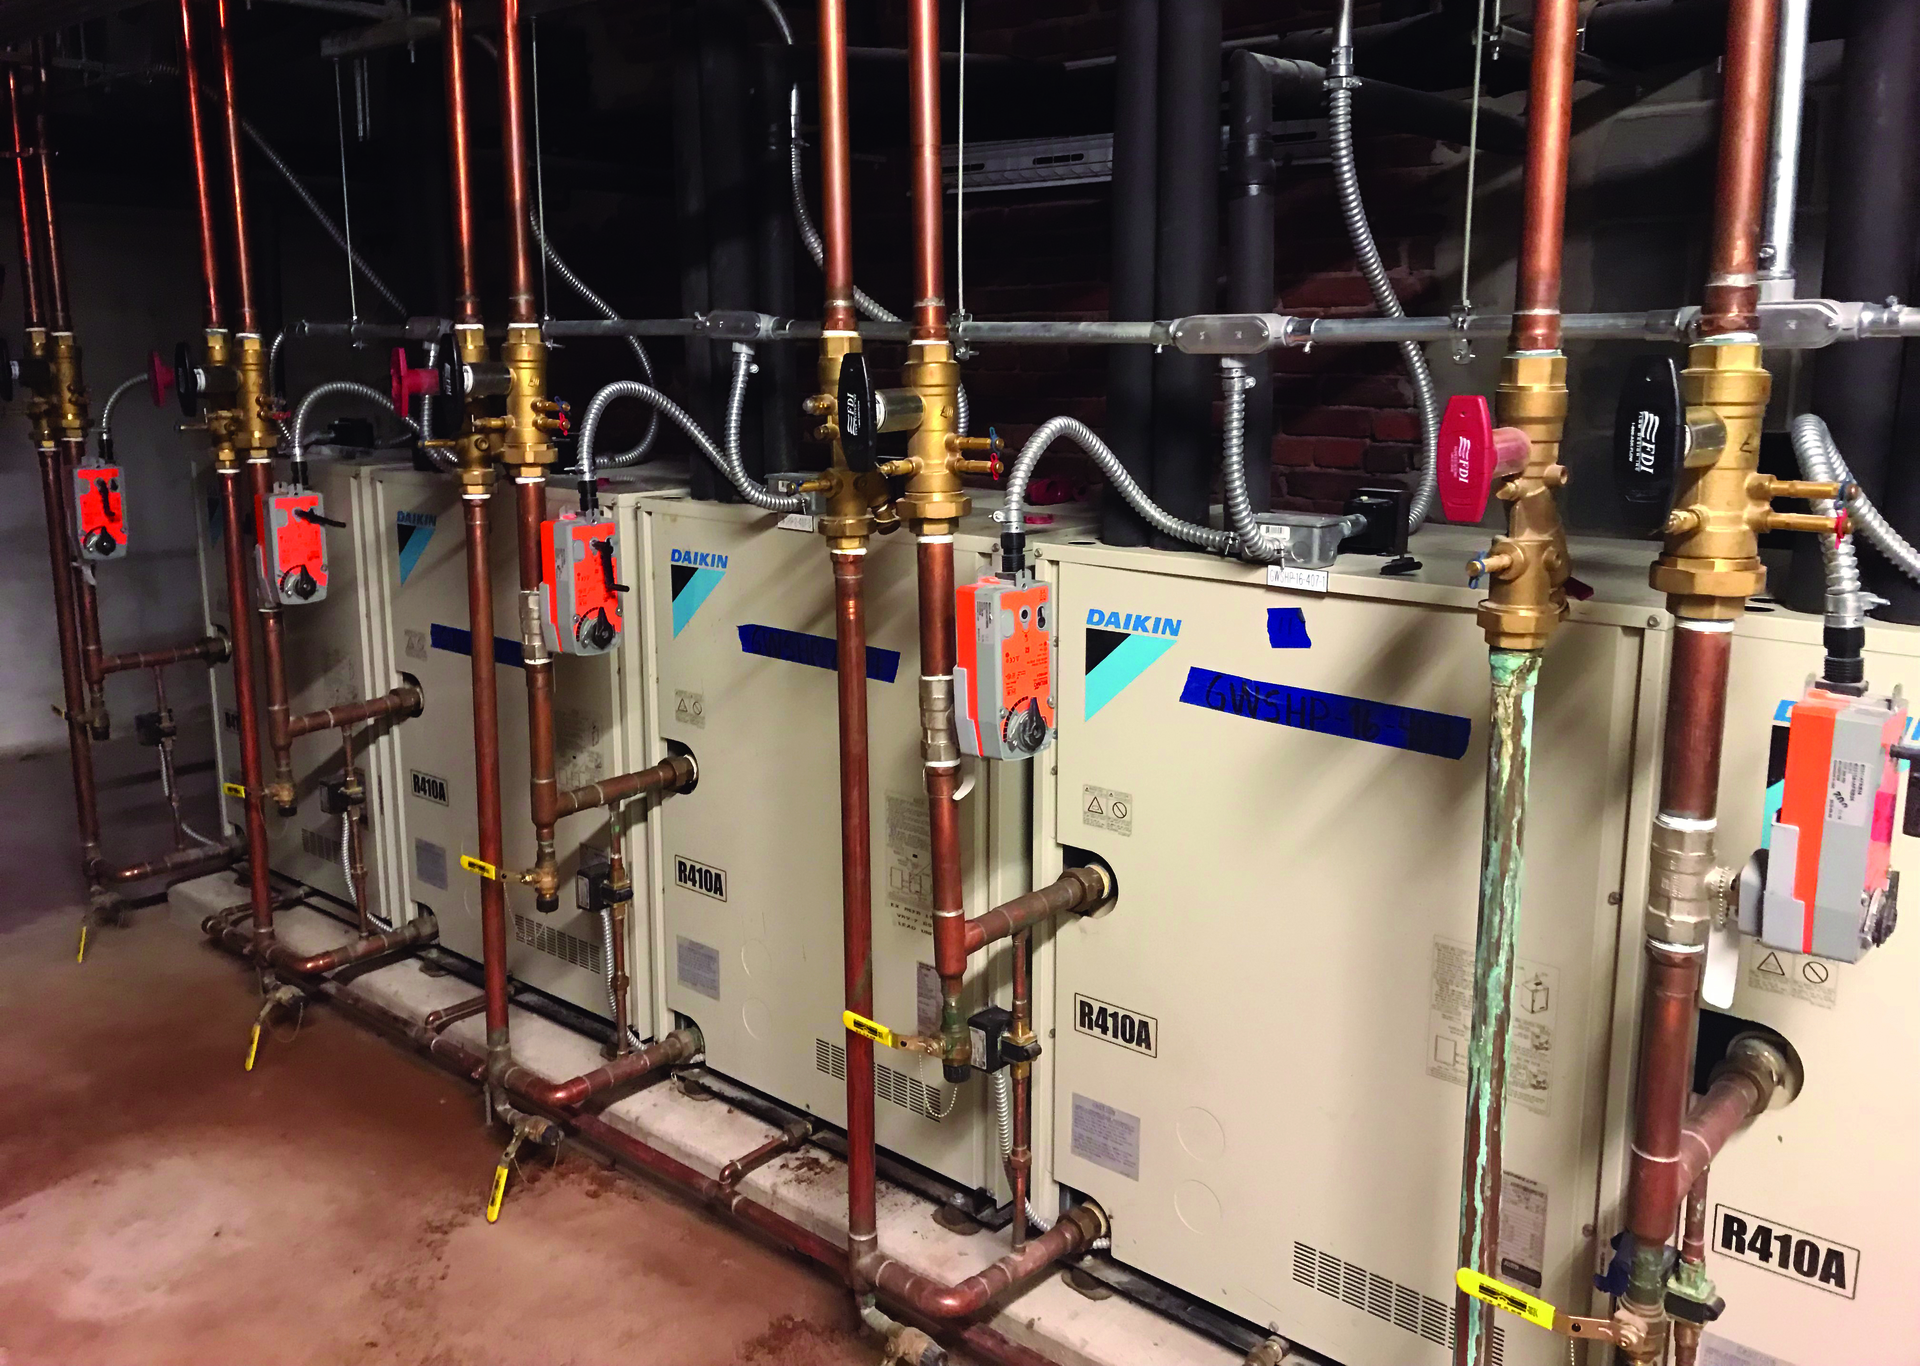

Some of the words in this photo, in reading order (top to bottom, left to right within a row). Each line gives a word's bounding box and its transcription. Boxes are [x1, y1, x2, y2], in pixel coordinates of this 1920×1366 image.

[846, 392, 855, 415] FDI
[1458, 459, 1470, 484] FDI
[1641, 441, 1656, 475] FDI
[396, 510, 437, 527] DAIKIN
[670, 548, 728, 570] DAIKIN
[1086, 607, 1183, 637] DAIKIN
[413, 772, 447, 802] R410A
[677, 860, 724, 897] R410A
[1079, 999, 1152, 1051] R410A
[1720, 1212, 1847, 1290] R410A
